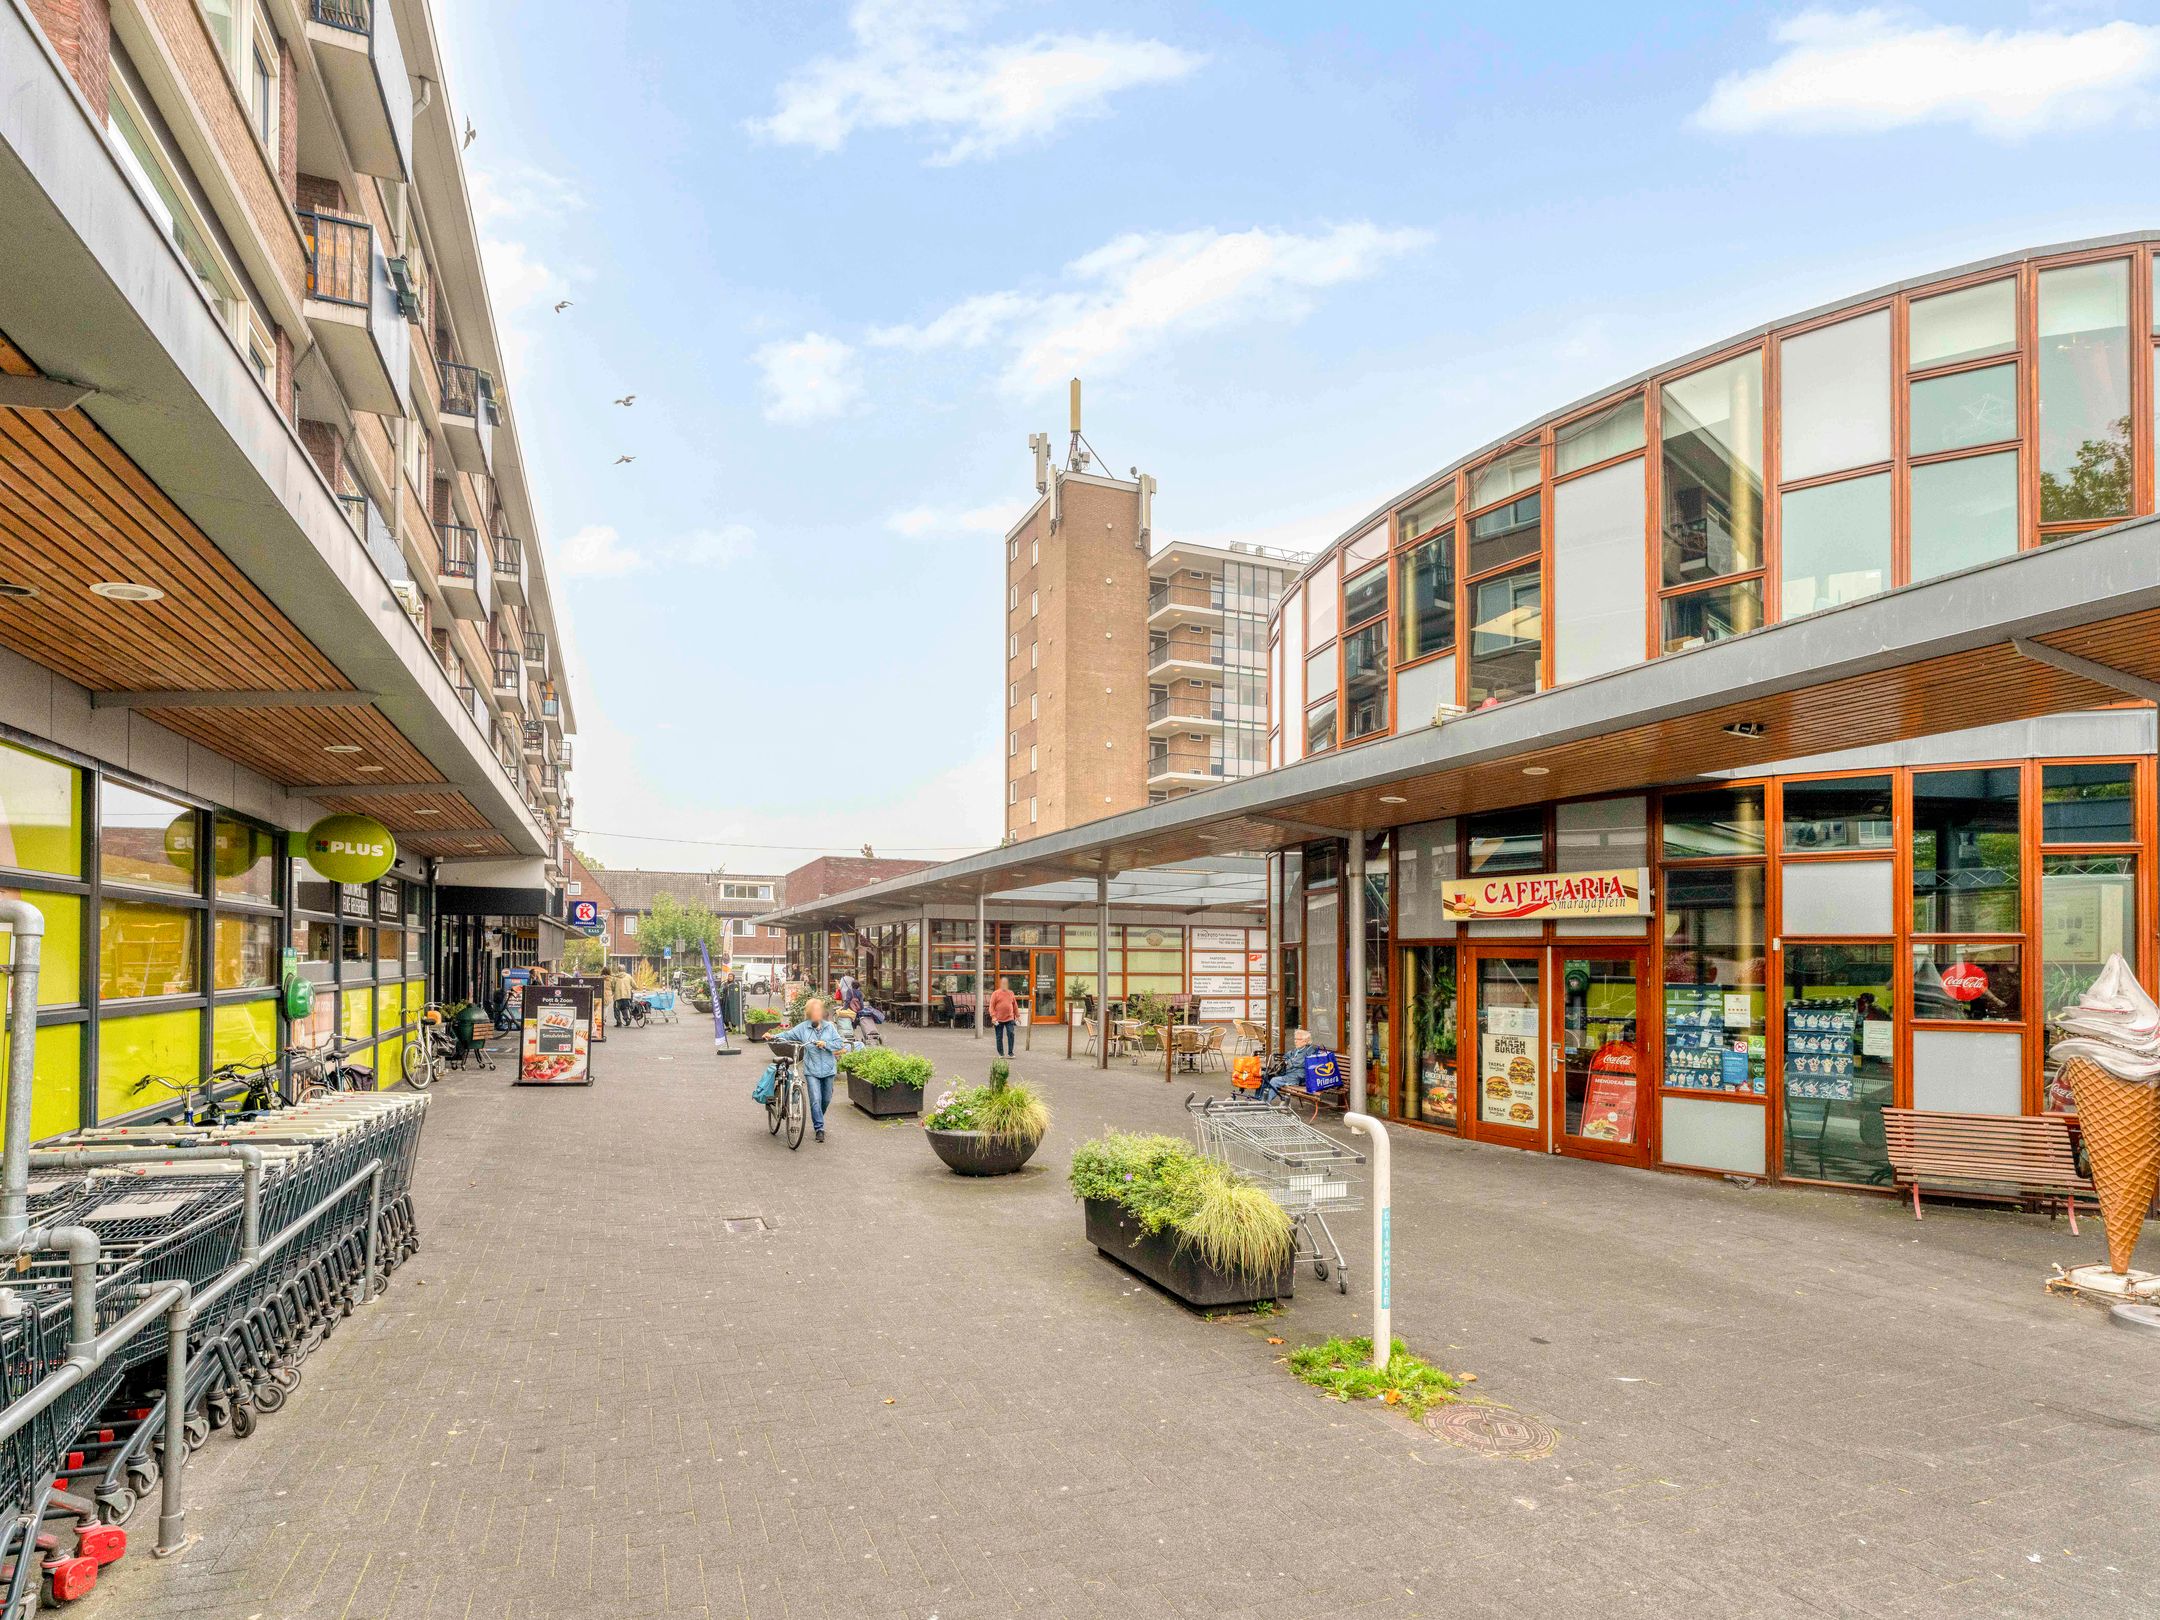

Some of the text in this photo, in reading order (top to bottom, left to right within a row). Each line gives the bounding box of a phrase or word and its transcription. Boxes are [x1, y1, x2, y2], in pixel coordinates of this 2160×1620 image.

[330, 841, 384, 857] PLUS
[1484, 875, 1625, 906] CAFETARIA
[1550, 894, 1627, 912] Smaragdplein
[1495, 1039, 1526, 1049] SMASH
[1495, 1047, 1526, 1055] BURGER
[1316, 1076, 1340, 1087] Primera
